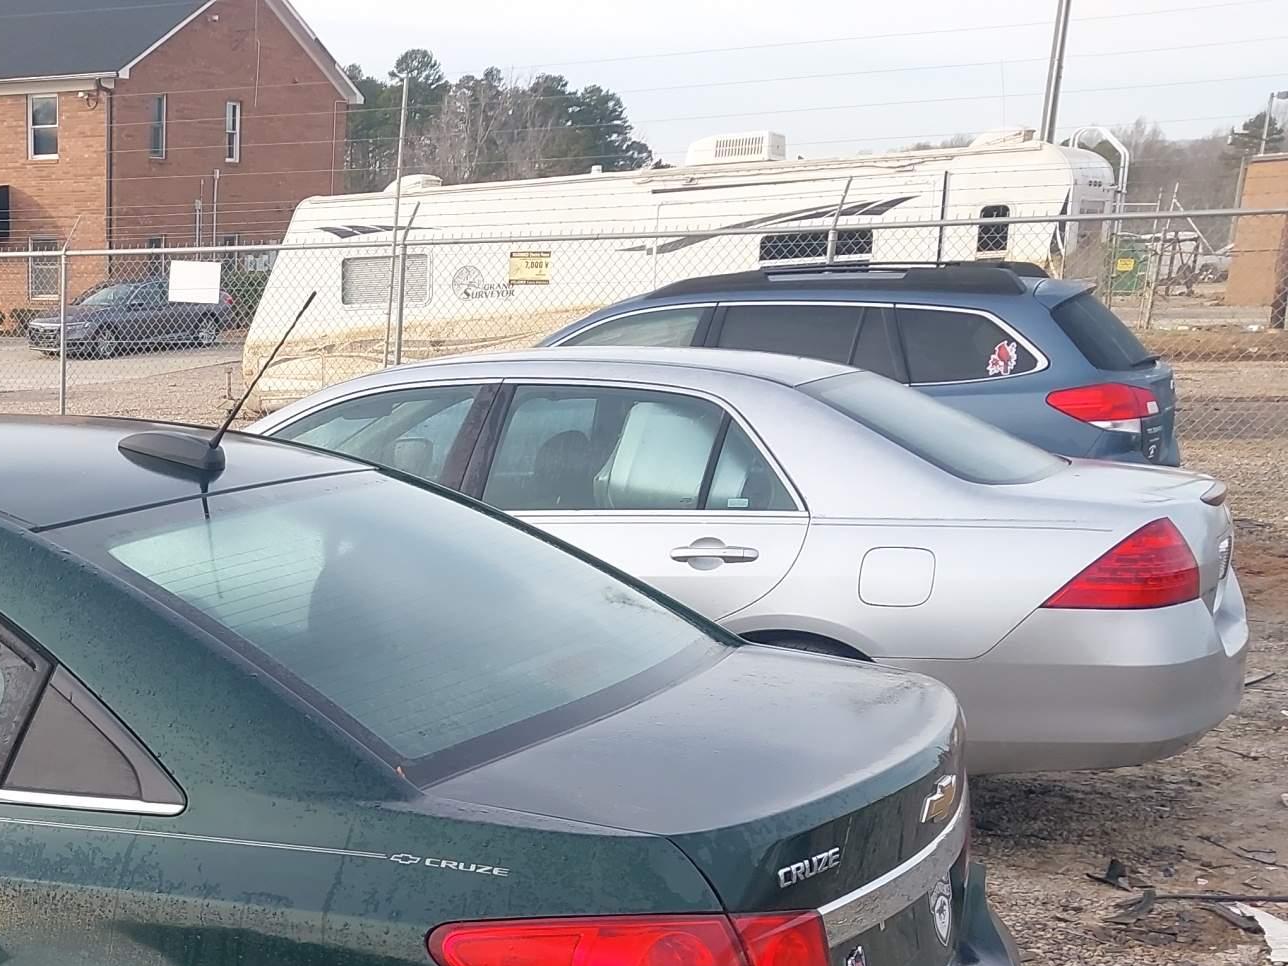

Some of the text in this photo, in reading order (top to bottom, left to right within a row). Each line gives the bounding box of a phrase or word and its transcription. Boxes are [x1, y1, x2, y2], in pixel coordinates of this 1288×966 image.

[462, 287, 516, 300] SURVEYOR
[424, 857, 512, 877] CRUZE
[777, 846, 841, 889] CRUZE
